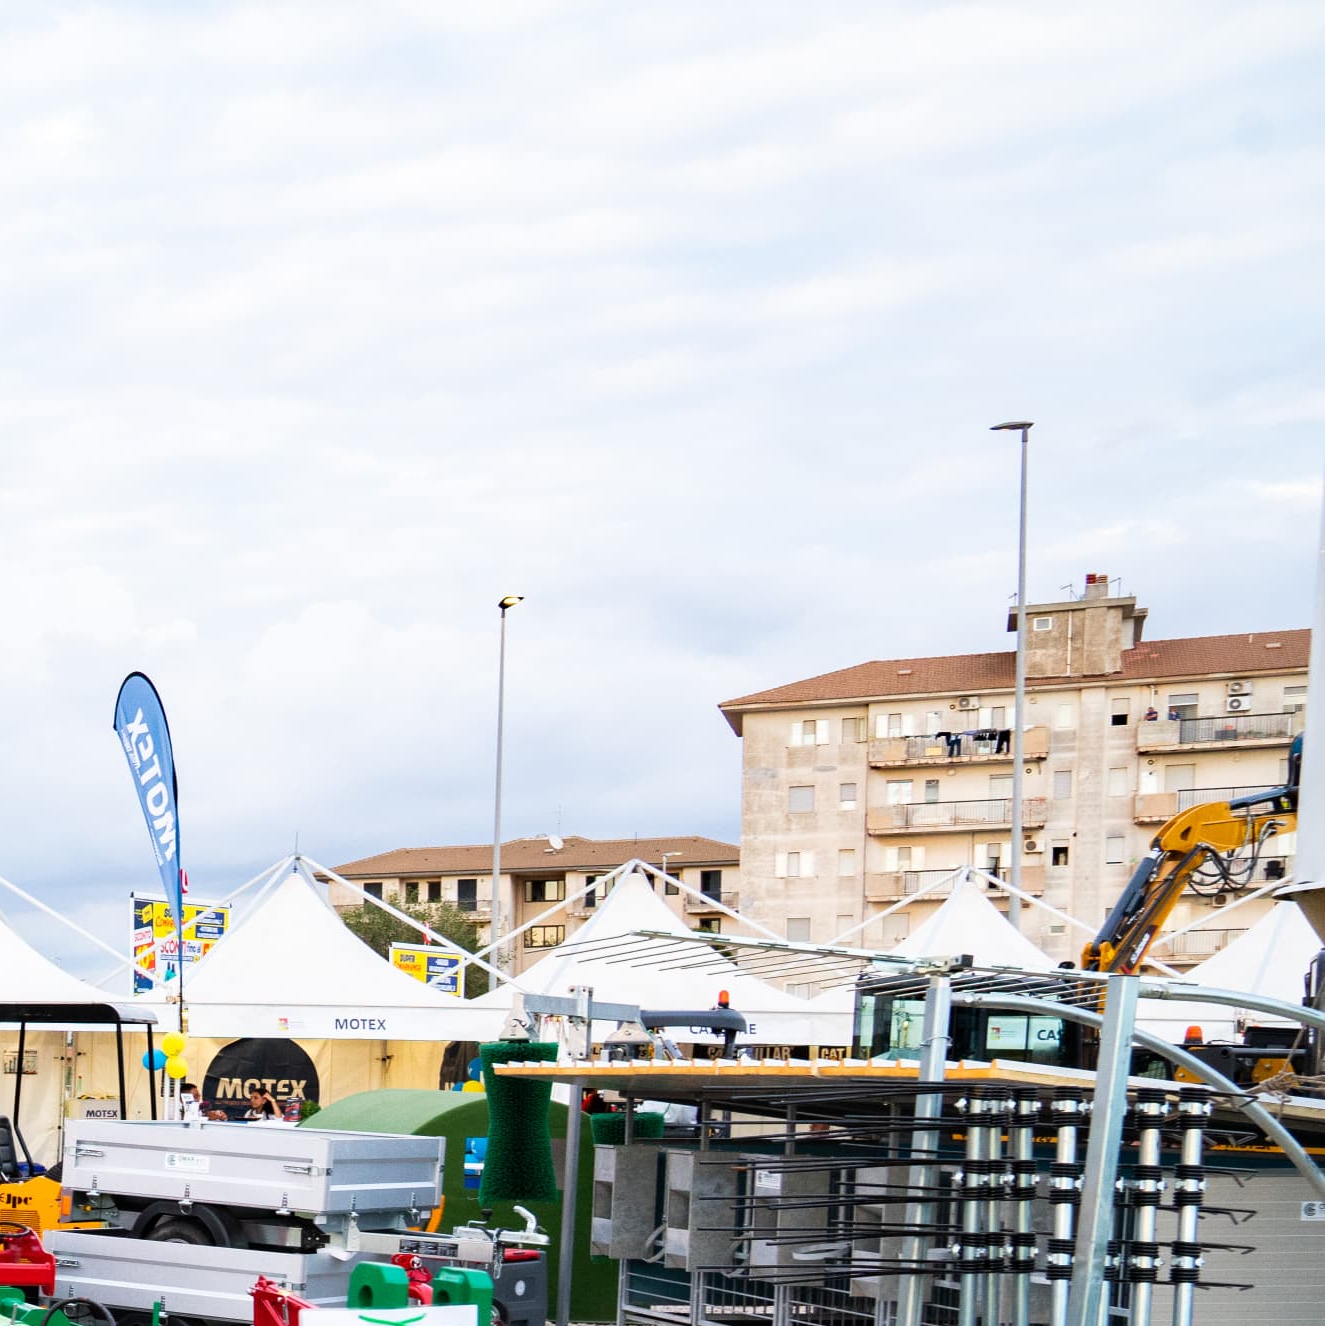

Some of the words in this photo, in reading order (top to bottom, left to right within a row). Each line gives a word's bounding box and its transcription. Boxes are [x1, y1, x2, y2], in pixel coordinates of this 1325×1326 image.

[335, 1018, 386, 1031] MOTEX
[216, 1078, 307, 1099] MOTEX
[85, 1110, 118, 1118] MOTEX
